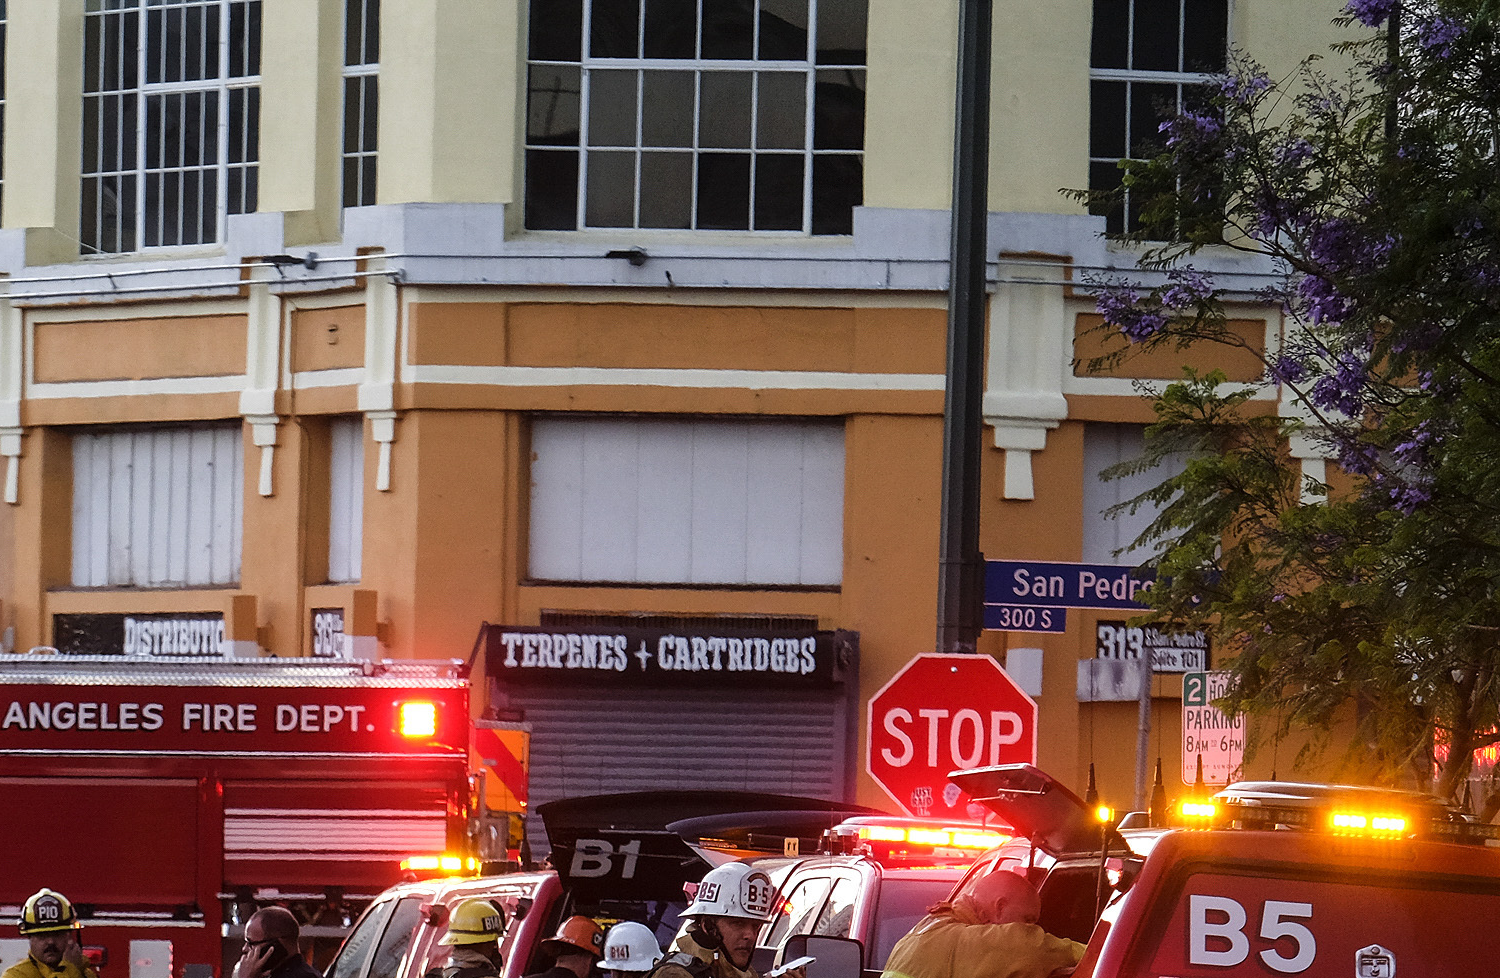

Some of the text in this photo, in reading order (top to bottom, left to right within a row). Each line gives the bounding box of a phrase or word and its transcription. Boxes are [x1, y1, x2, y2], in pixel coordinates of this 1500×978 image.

[1012, 568, 1064, 598] San
[1000, 608, 1052, 629] 300 S
[502, 633, 627, 671] TERPENES
[658, 635, 816, 675] CARTRIDGES
[1098, 625, 1144, 660] 313
[1181, 651, 1199, 668] 101
[1188, 678, 1201, 702] 2
[2, 702, 163, 730] ANGELES
[183, 704, 257, 731] FIRE
[276, 705, 376, 732] DEPT.
[1186, 710, 1241, 730] PARKING
[881, 707, 1023, 770] STOP
[1186, 736, 1208, 752] 8AM
[1220, 736, 1242, 752] 6PM
[570, 838, 642, 879] B1
[700, 882, 716, 900] B5
[1190, 894, 1317, 973] B5
